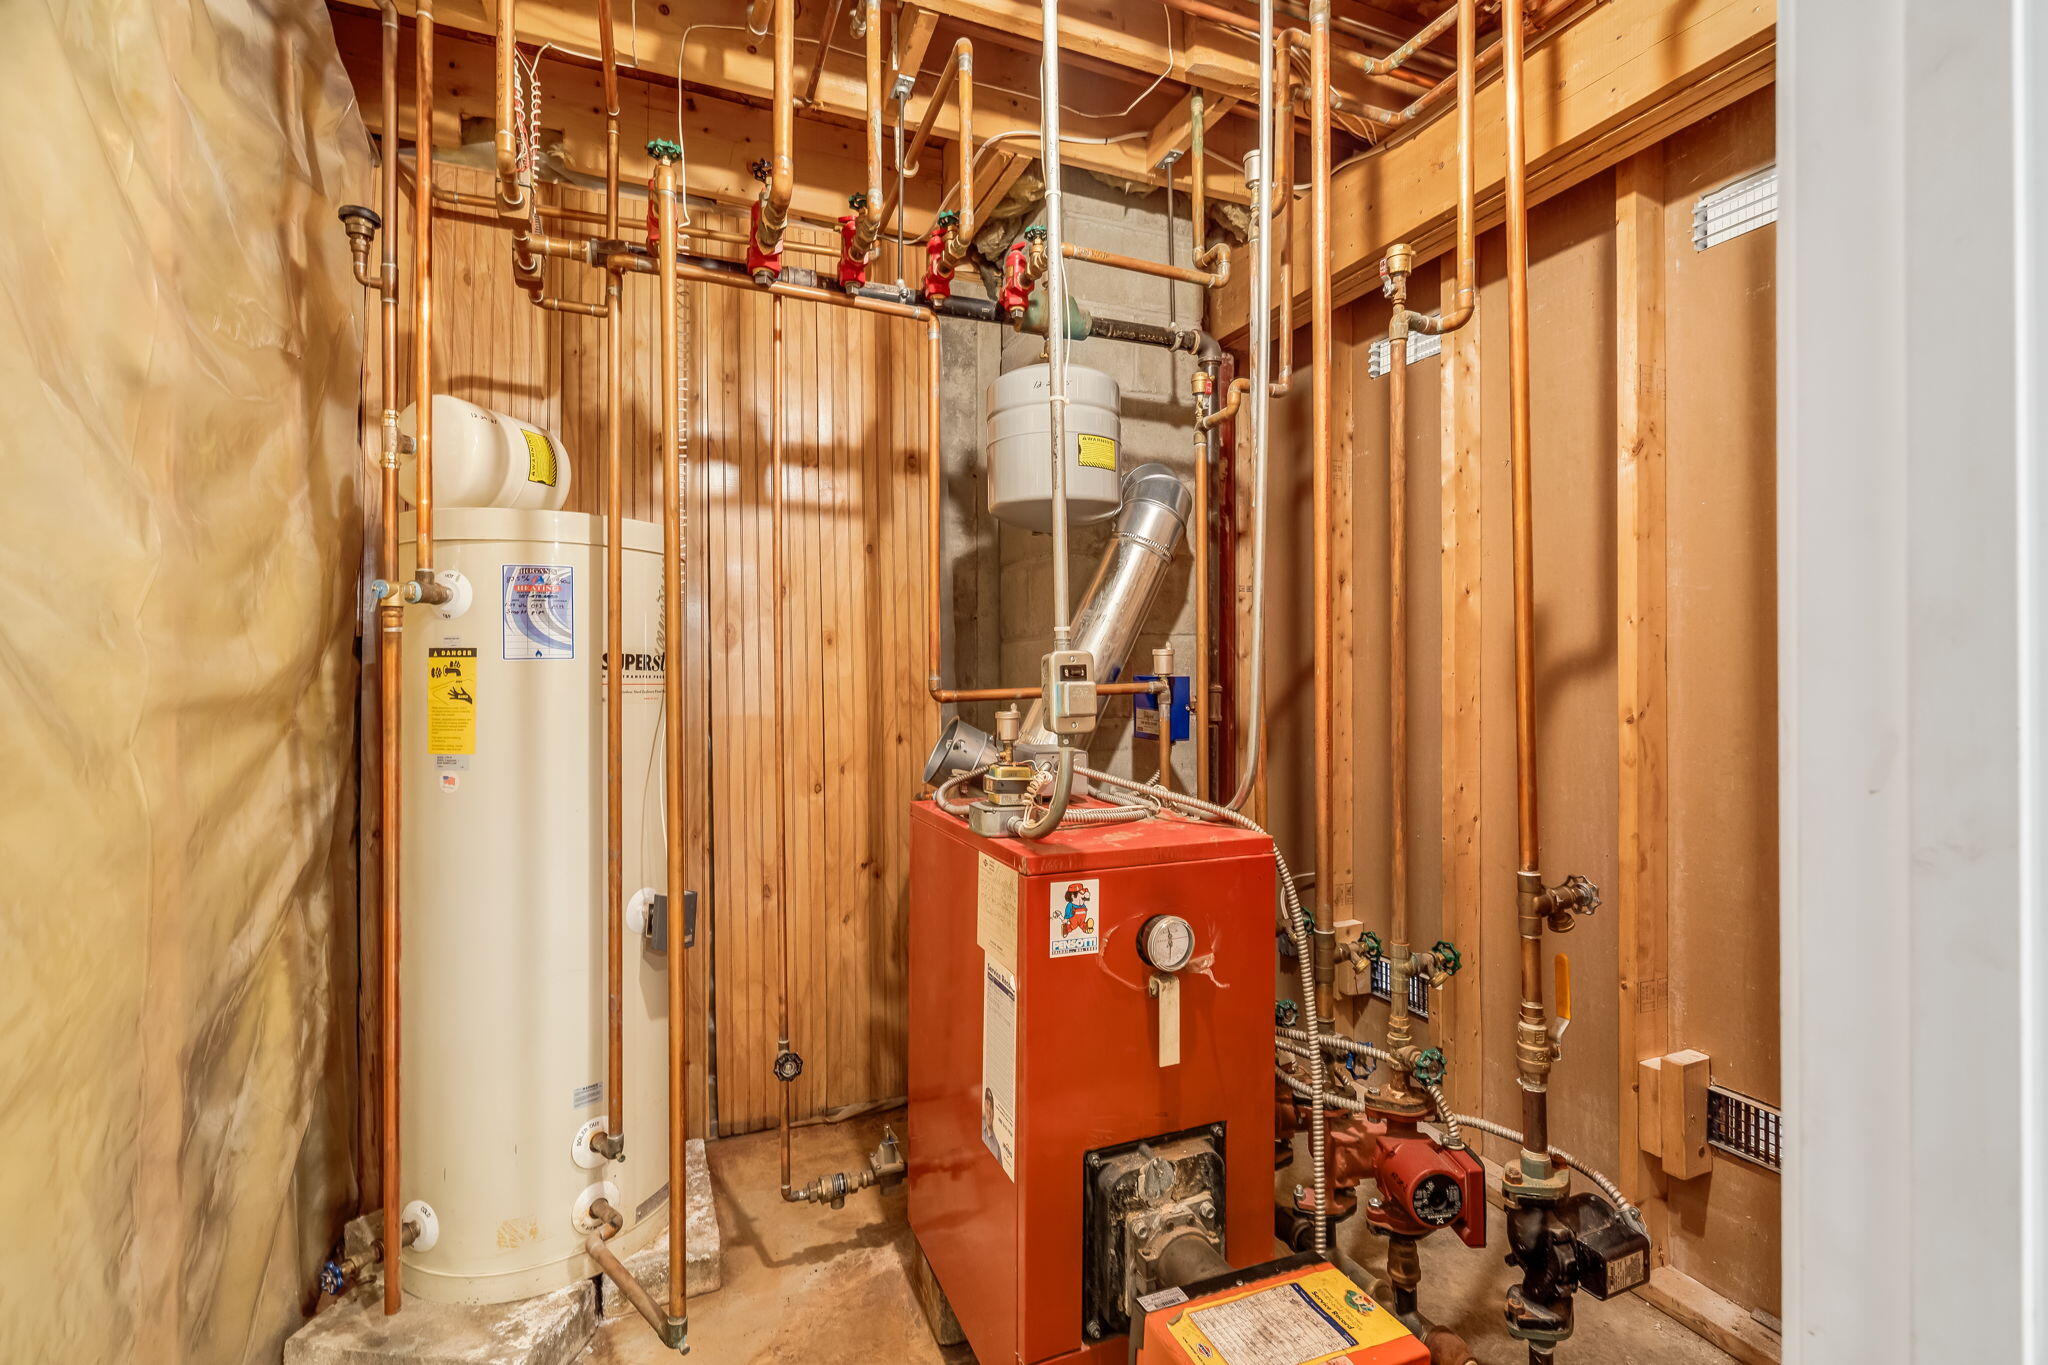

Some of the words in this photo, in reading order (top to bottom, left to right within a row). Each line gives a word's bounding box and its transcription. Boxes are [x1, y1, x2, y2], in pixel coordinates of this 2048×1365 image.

[601, 652, 665, 672] SPERSt
[1311, 1290, 1332, 1310] Service
[1332, 1310, 1355, 1330] Record
